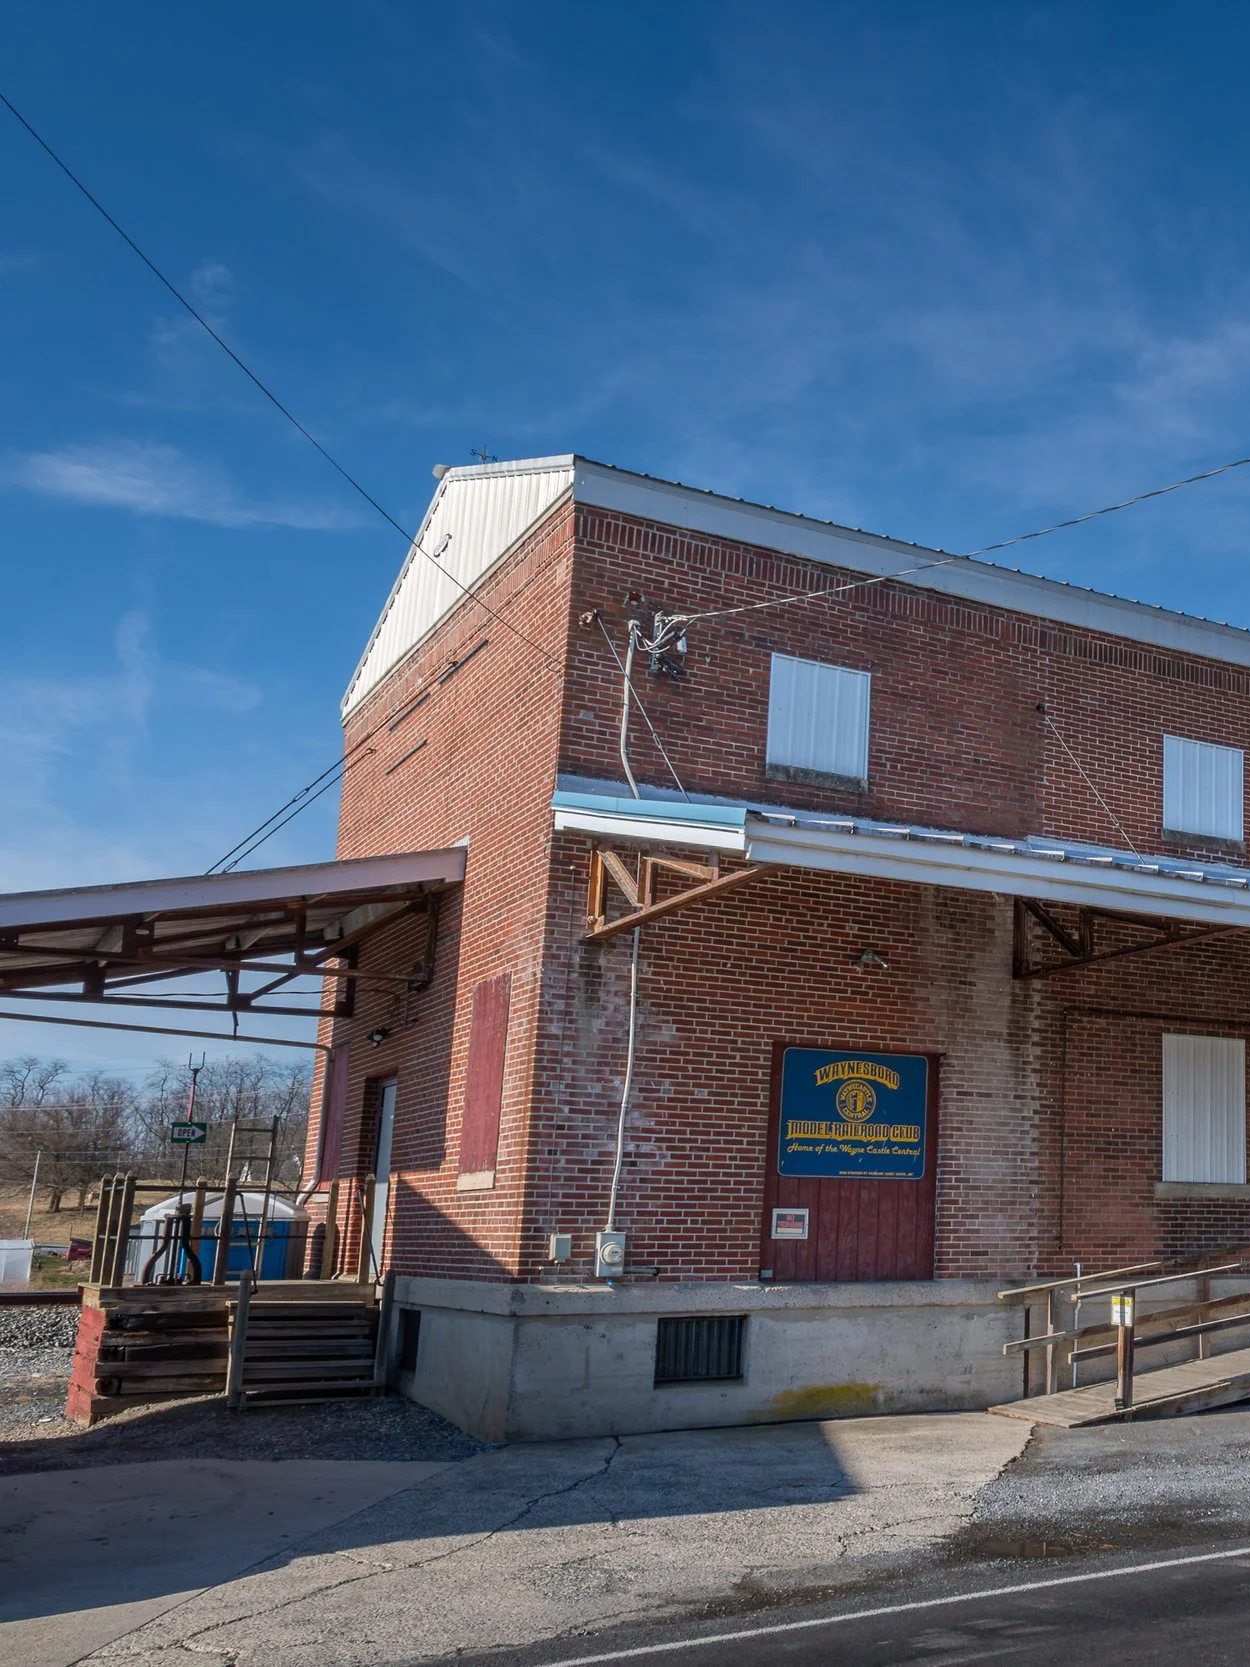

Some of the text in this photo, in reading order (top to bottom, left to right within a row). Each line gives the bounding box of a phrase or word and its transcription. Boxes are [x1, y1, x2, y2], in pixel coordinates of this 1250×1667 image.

[814, 1060, 900, 1090] WAYNESBORO
[178, 1129, 196, 1137] OPEN
[785, 1120, 920, 1142] MODEL RAILROAD CLUB
[787, 1142, 921, 1156] Home of the Wayne Castle Central
